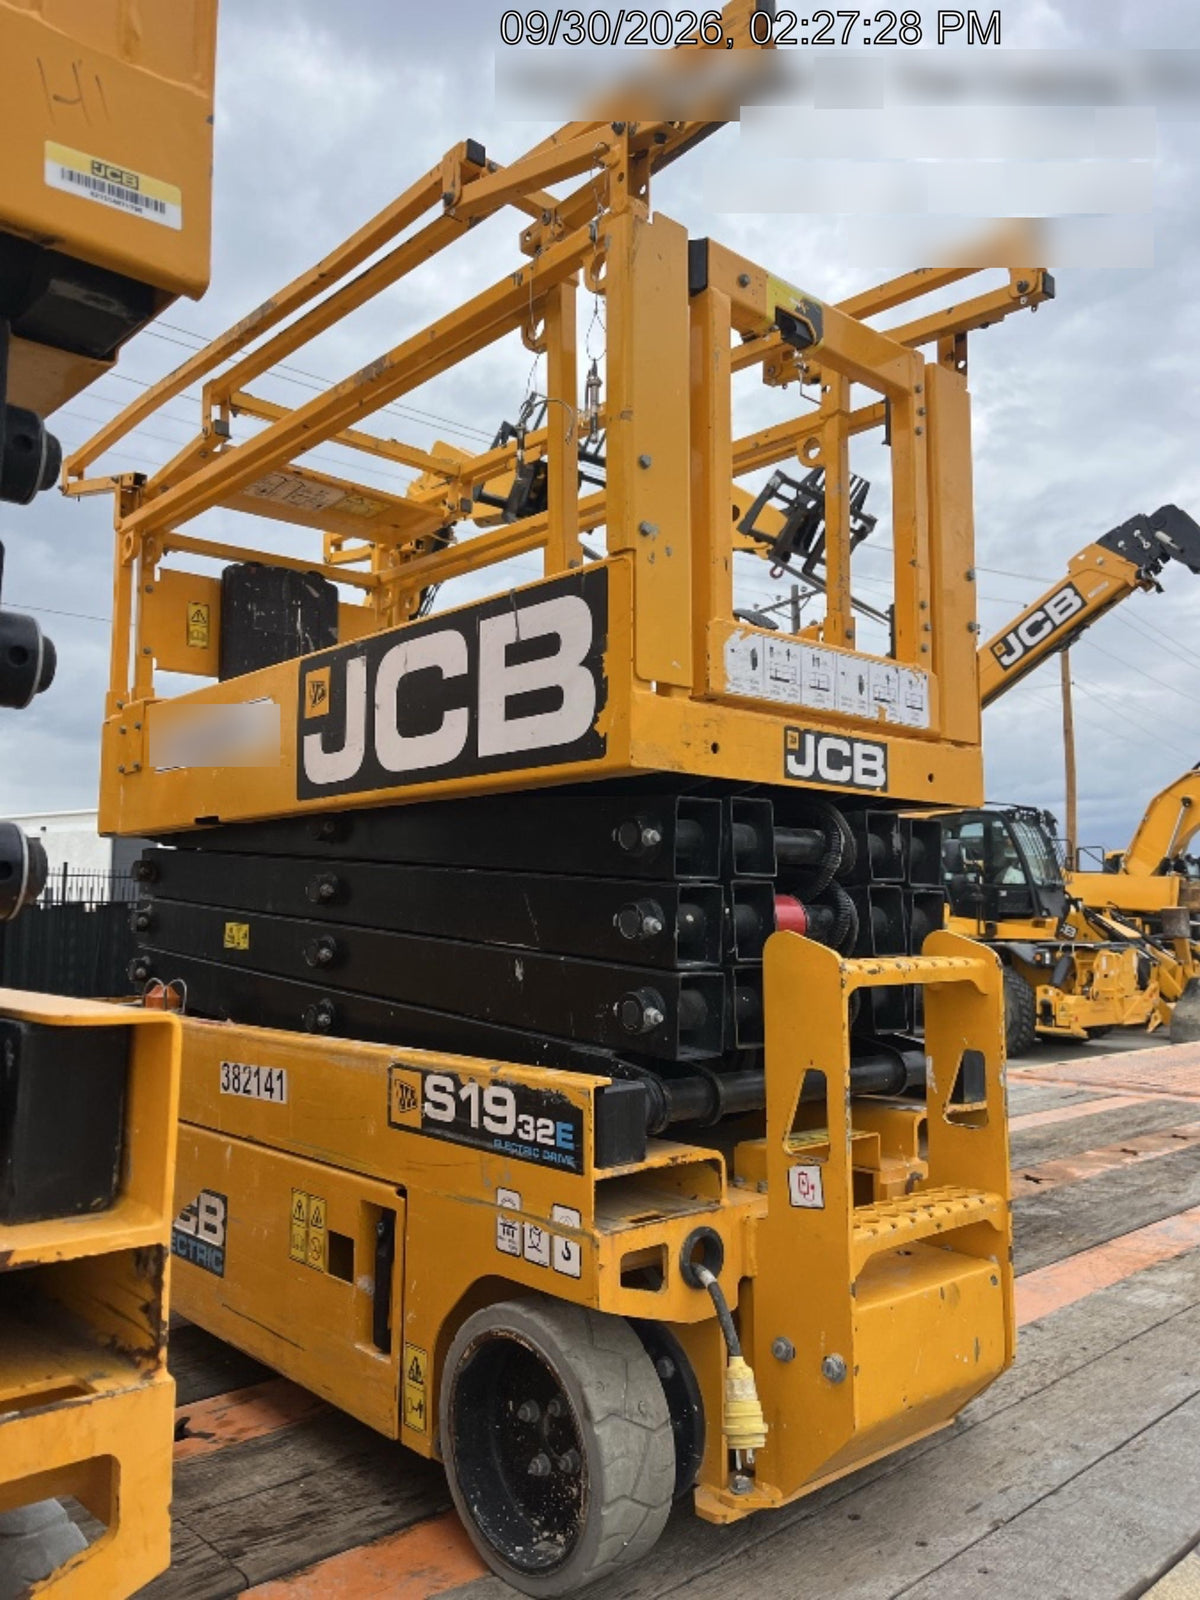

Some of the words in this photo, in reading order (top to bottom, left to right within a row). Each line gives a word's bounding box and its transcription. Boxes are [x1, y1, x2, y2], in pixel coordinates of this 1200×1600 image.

[93, 160, 138, 190] JCB
[1000, 587, 1082, 666] JCB
[303, 594, 597, 785] JCB
[786, 733, 886, 787] JCB
[221, 1062, 284, 1101] 382141
[493, 1138, 541, 1159] ELECTRIC
[543, 1149, 576, 1168] DRIVE
